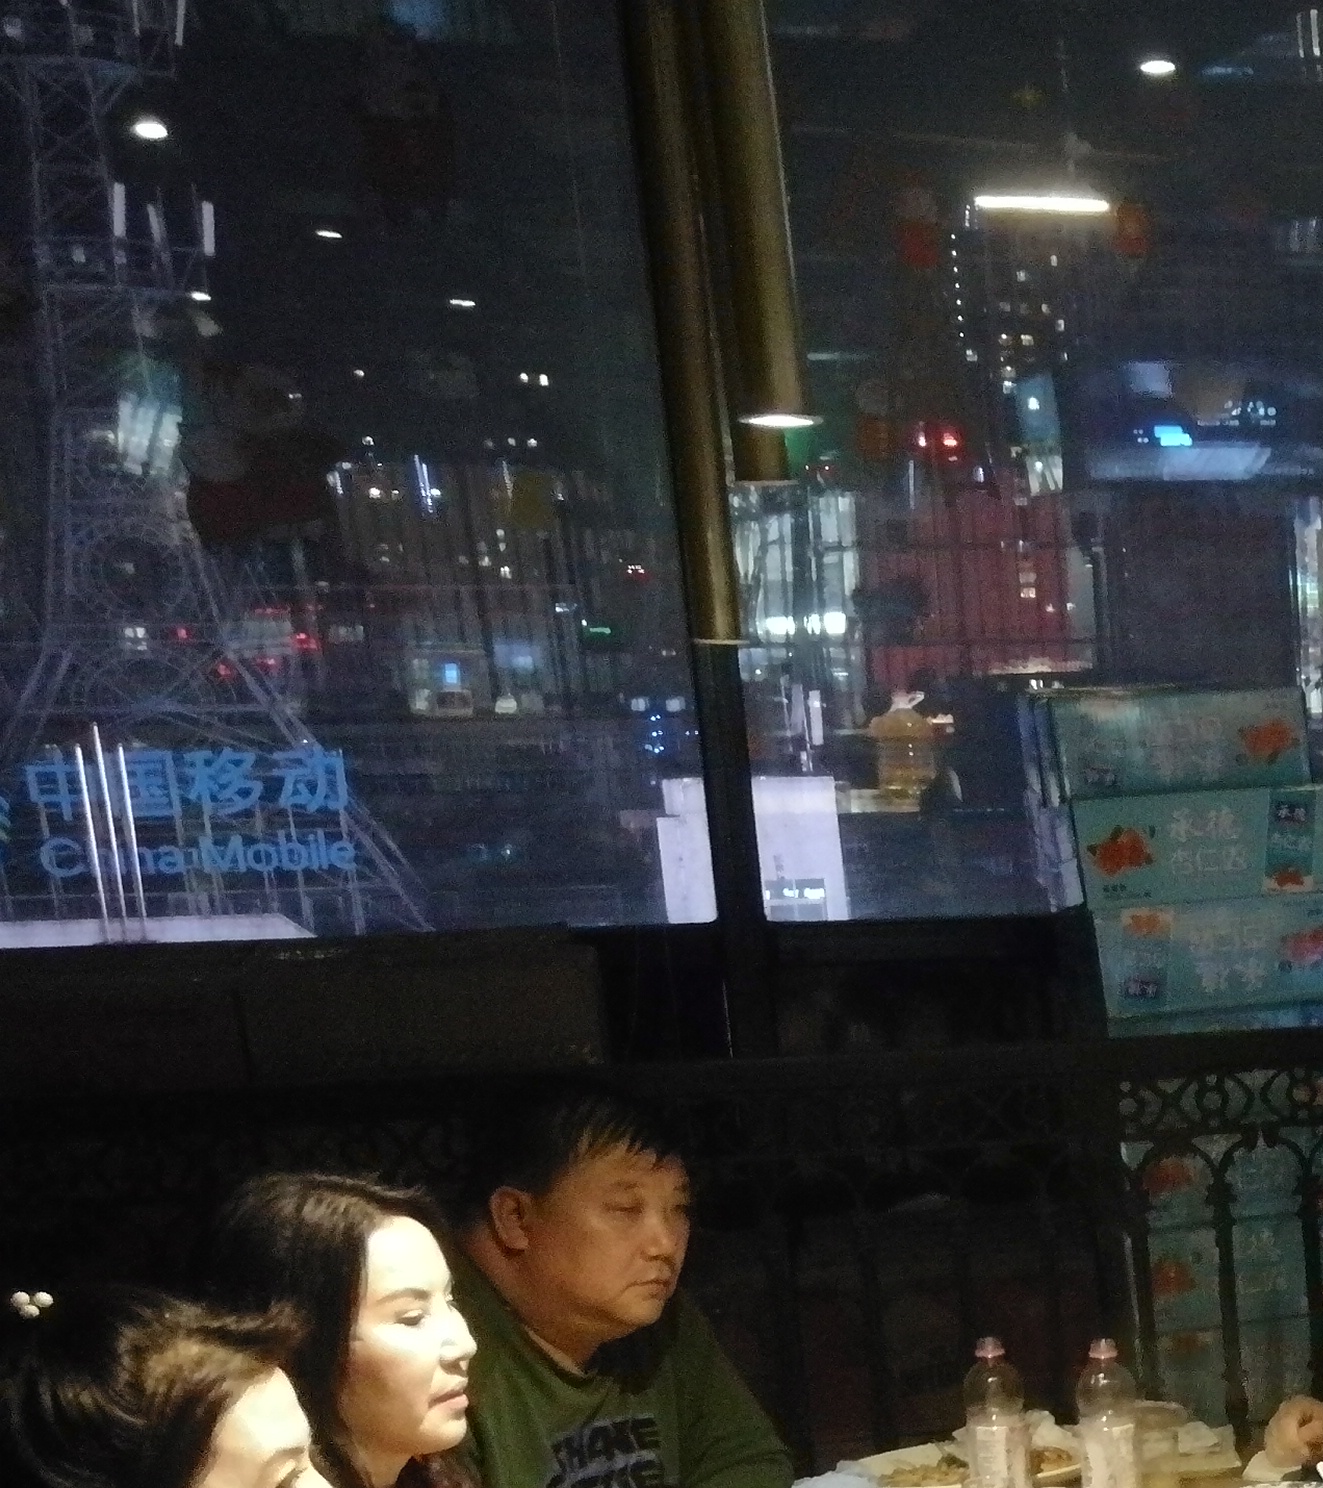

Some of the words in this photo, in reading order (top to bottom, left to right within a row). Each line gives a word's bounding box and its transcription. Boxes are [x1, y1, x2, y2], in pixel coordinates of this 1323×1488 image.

[24, 747, 348, 822] 中国移动
[198, 828, 356, 873] Mobile
